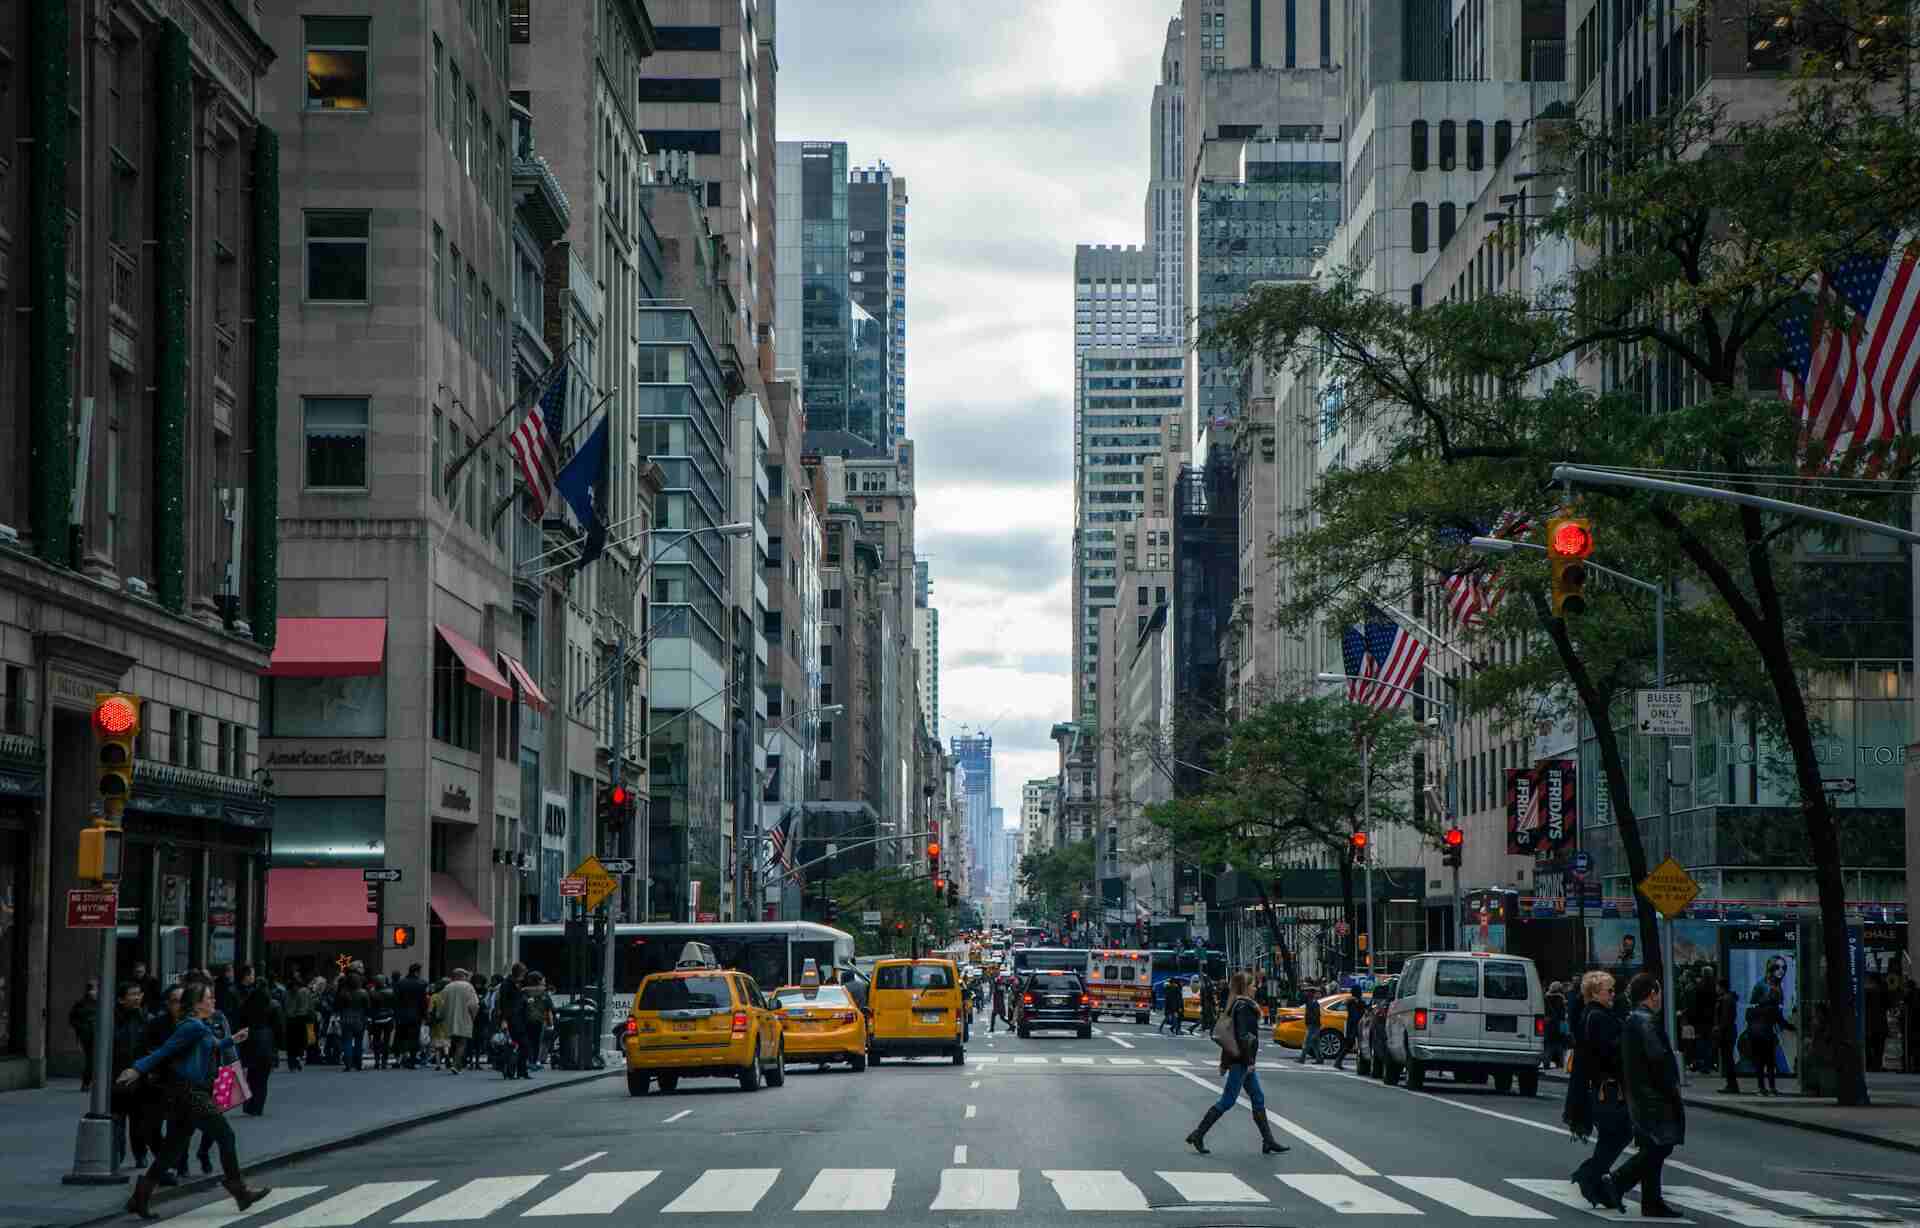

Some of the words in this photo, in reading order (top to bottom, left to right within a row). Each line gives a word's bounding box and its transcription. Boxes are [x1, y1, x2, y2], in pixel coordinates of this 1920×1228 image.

[1647, 692, 1681, 703] BUSES
[1650, 709, 1679, 719] ONLY
[266, 749, 327, 765] American
[329, 749, 351, 765] Girl
[353, 750, 385, 765] Place
[1548, 778, 1562, 840] FRIDAYS
